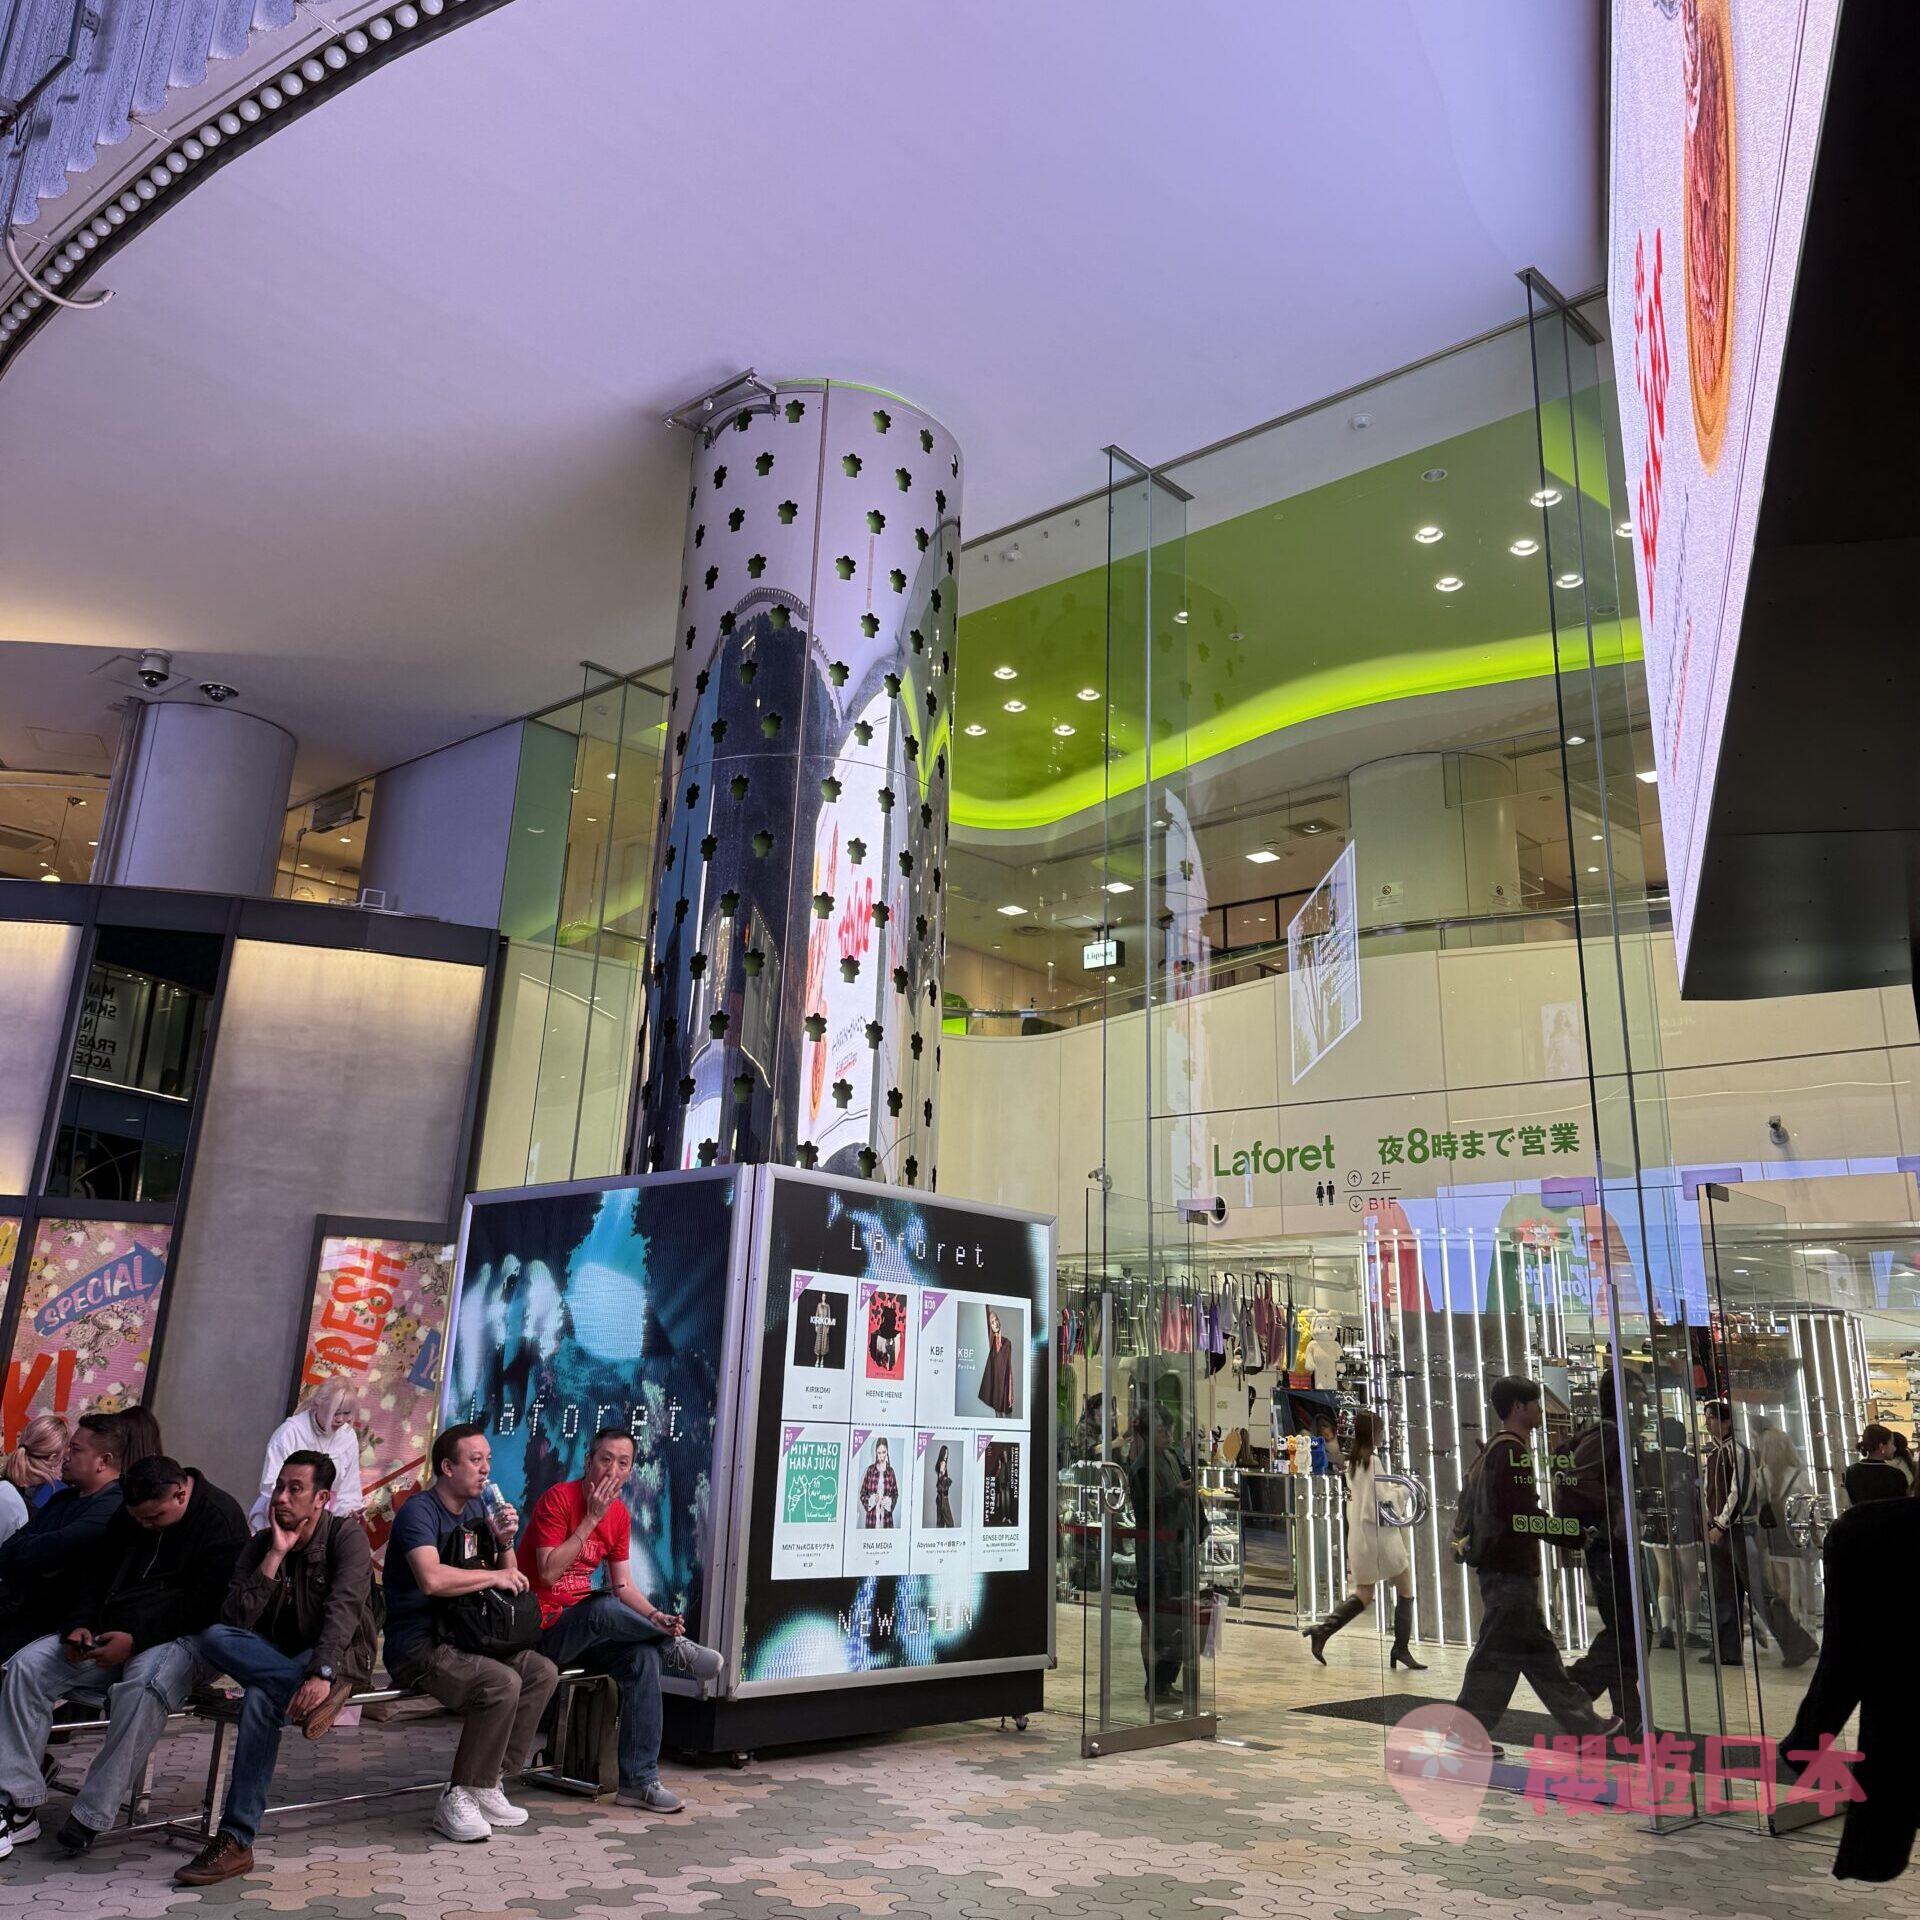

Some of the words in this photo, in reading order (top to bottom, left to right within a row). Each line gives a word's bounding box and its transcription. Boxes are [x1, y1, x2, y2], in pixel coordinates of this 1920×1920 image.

[1378, 1122, 1580, 1166] 夜8時まで営業
[1213, 1134, 1335, 1177] Laforet
[1371, 1171, 1391, 1185] 2F
[1369, 1196, 1397, 1211] B1F
[851, 1224, 984, 1268] Laforet
[43, 1255, 152, 1328] SPECIAL
[930, 1346, 944, 1356] KBF
[958, 1348, 974, 1358] KBF
[805, 1386, 831, 1394] KIRIKOMI
[790, 1443, 815, 1455] MINT
[817, 1443, 839, 1456] NeKO
[789, 1457, 838, 1471] HARAJUKU
[1005, 1533, 1019, 1541] PLACE
[875, 1542, 893, 1550] MEDIA
[837, 1606, 895, 1638] NEW
[907, 1604, 973, 1634] OPEN
